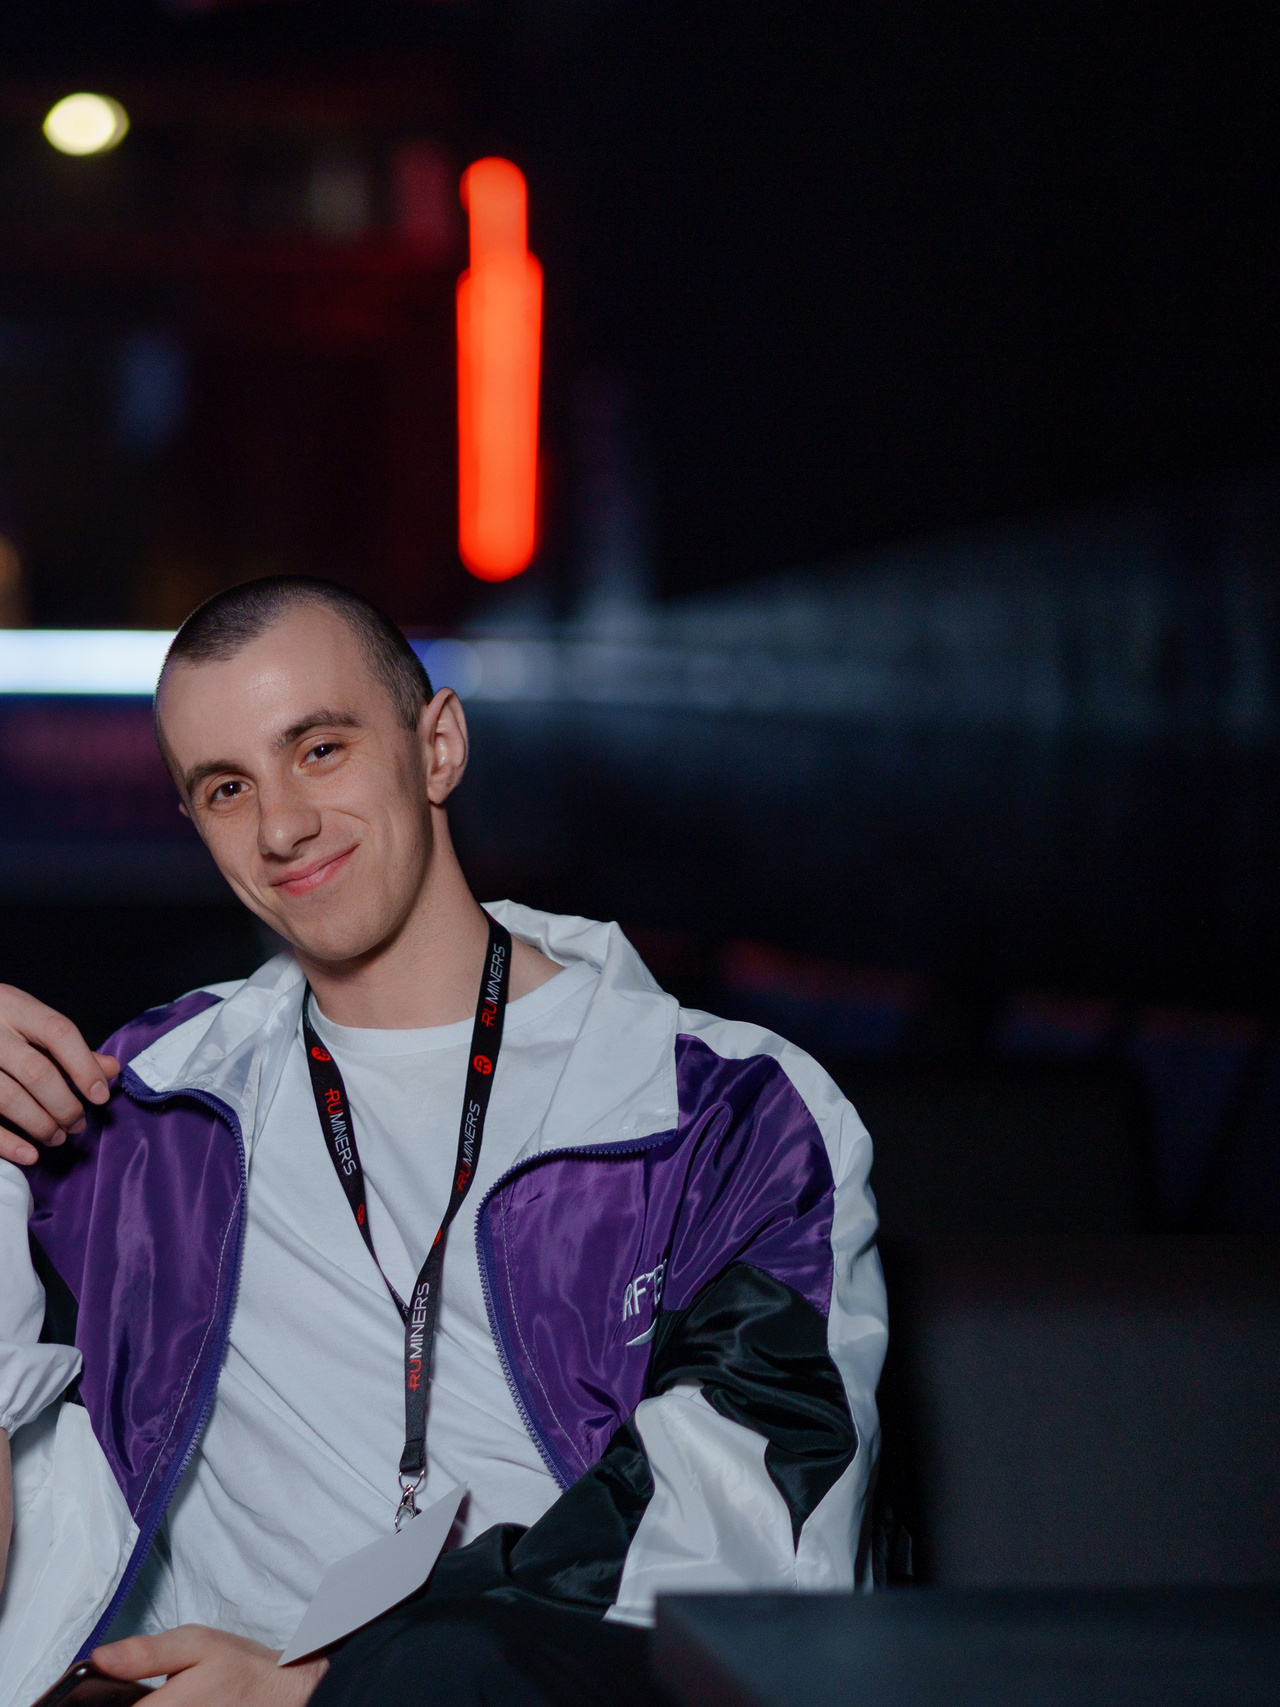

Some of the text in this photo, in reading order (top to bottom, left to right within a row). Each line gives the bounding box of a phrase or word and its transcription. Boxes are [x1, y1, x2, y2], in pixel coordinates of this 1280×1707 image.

[481, 943, 506, 1027] RUMINERS
[324, 1088, 357, 1176] RUMINERS
[456, 1100, 481, 1192] RUMINERS
[409, 1282, 430, 1392] RUMINERS
